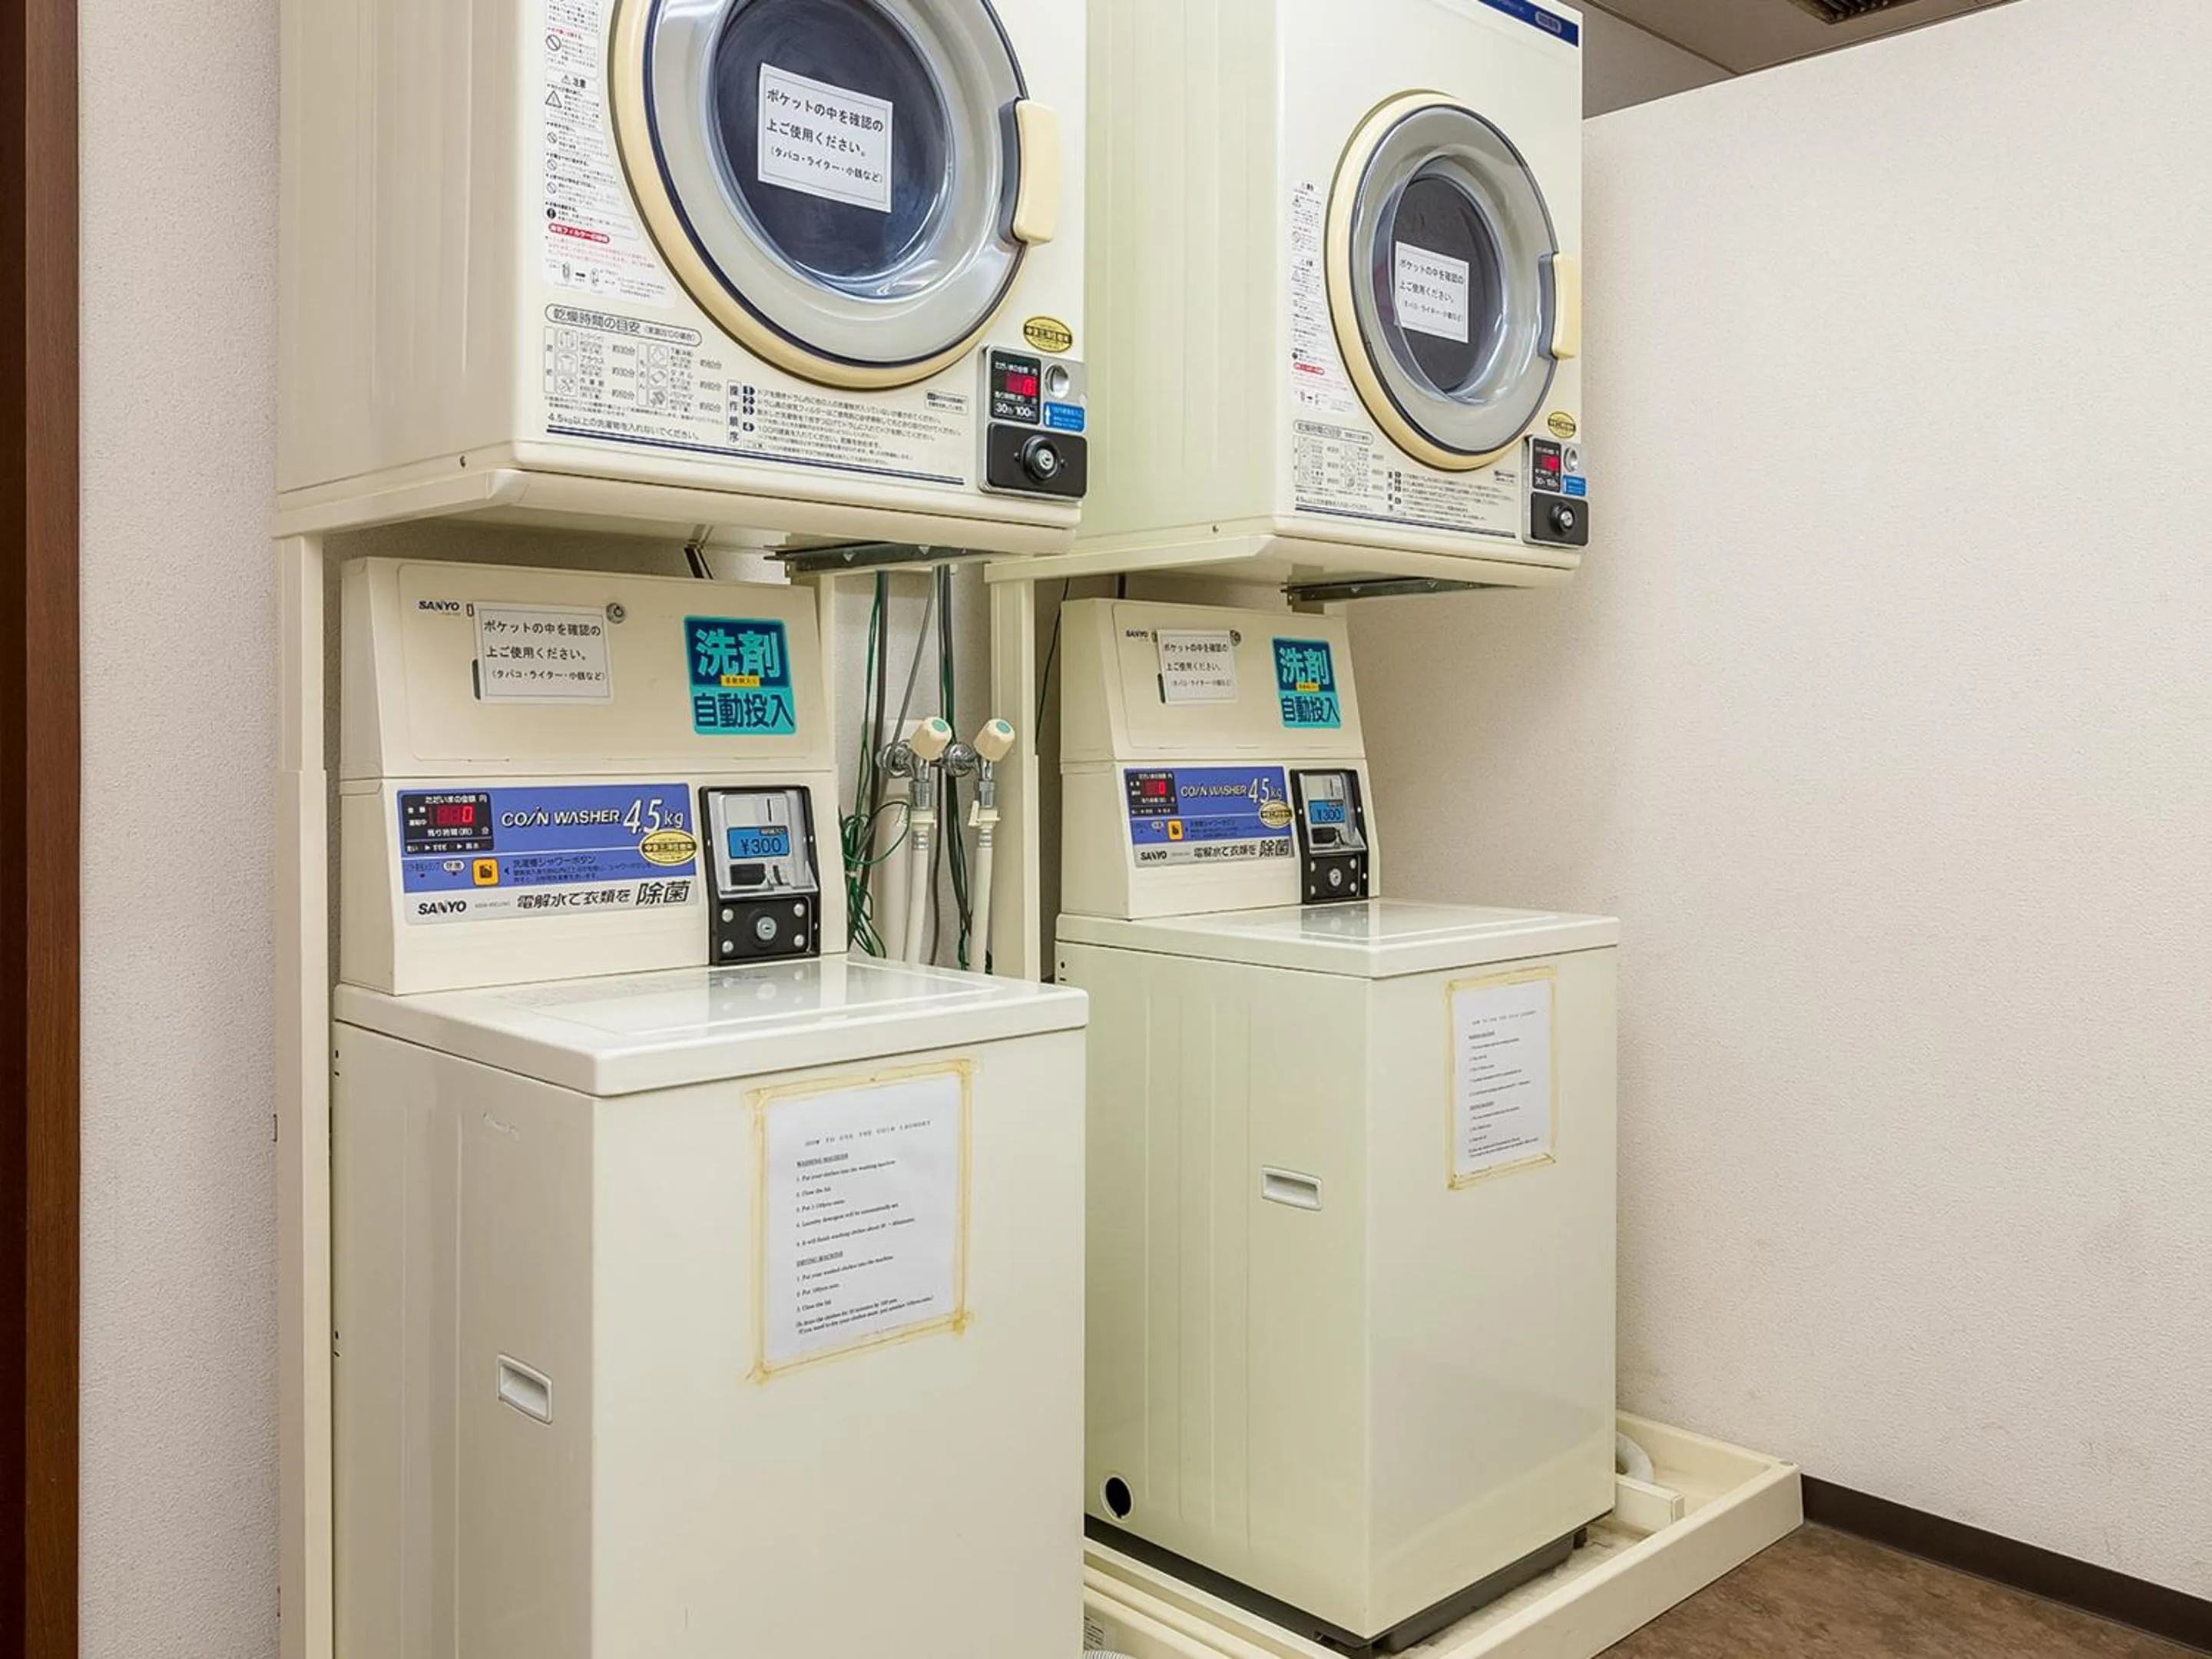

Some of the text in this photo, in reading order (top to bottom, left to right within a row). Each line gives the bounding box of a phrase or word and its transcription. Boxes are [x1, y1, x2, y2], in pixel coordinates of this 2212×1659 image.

[767, 88, 884, 133] ポケットの中を確認の
[767, 118, 866, 157] 上ご使用ください。
[419, 601, 460, 612] SANYO
[484, 620, 601, 637] ポケットの中を確認の
[486, 646, 587, 661] 上ご使用ください。
[696, 628, 781, 678] 洗剤
[1279, 647, 1330, 685] 洗剤
[694, 692, 794, 728] 自動投入
[1281, 695, 1341, 723] 自動投入
[1209, 786, 1247, 797] WASHER
[462, 806, 473, 823] 0
[501, 806, 550, 827] COIN
[554, 810, 621, 825] WASHER
[741, 837, 782, 854] ¥300
[1259, 839, 1290, 858] 除菌
[1141, 850, 1167, 861] SANYO
[517, 881, 691, 909] 電解水で衣類を 除菌
[418, 900, 467, 916] SANYO
